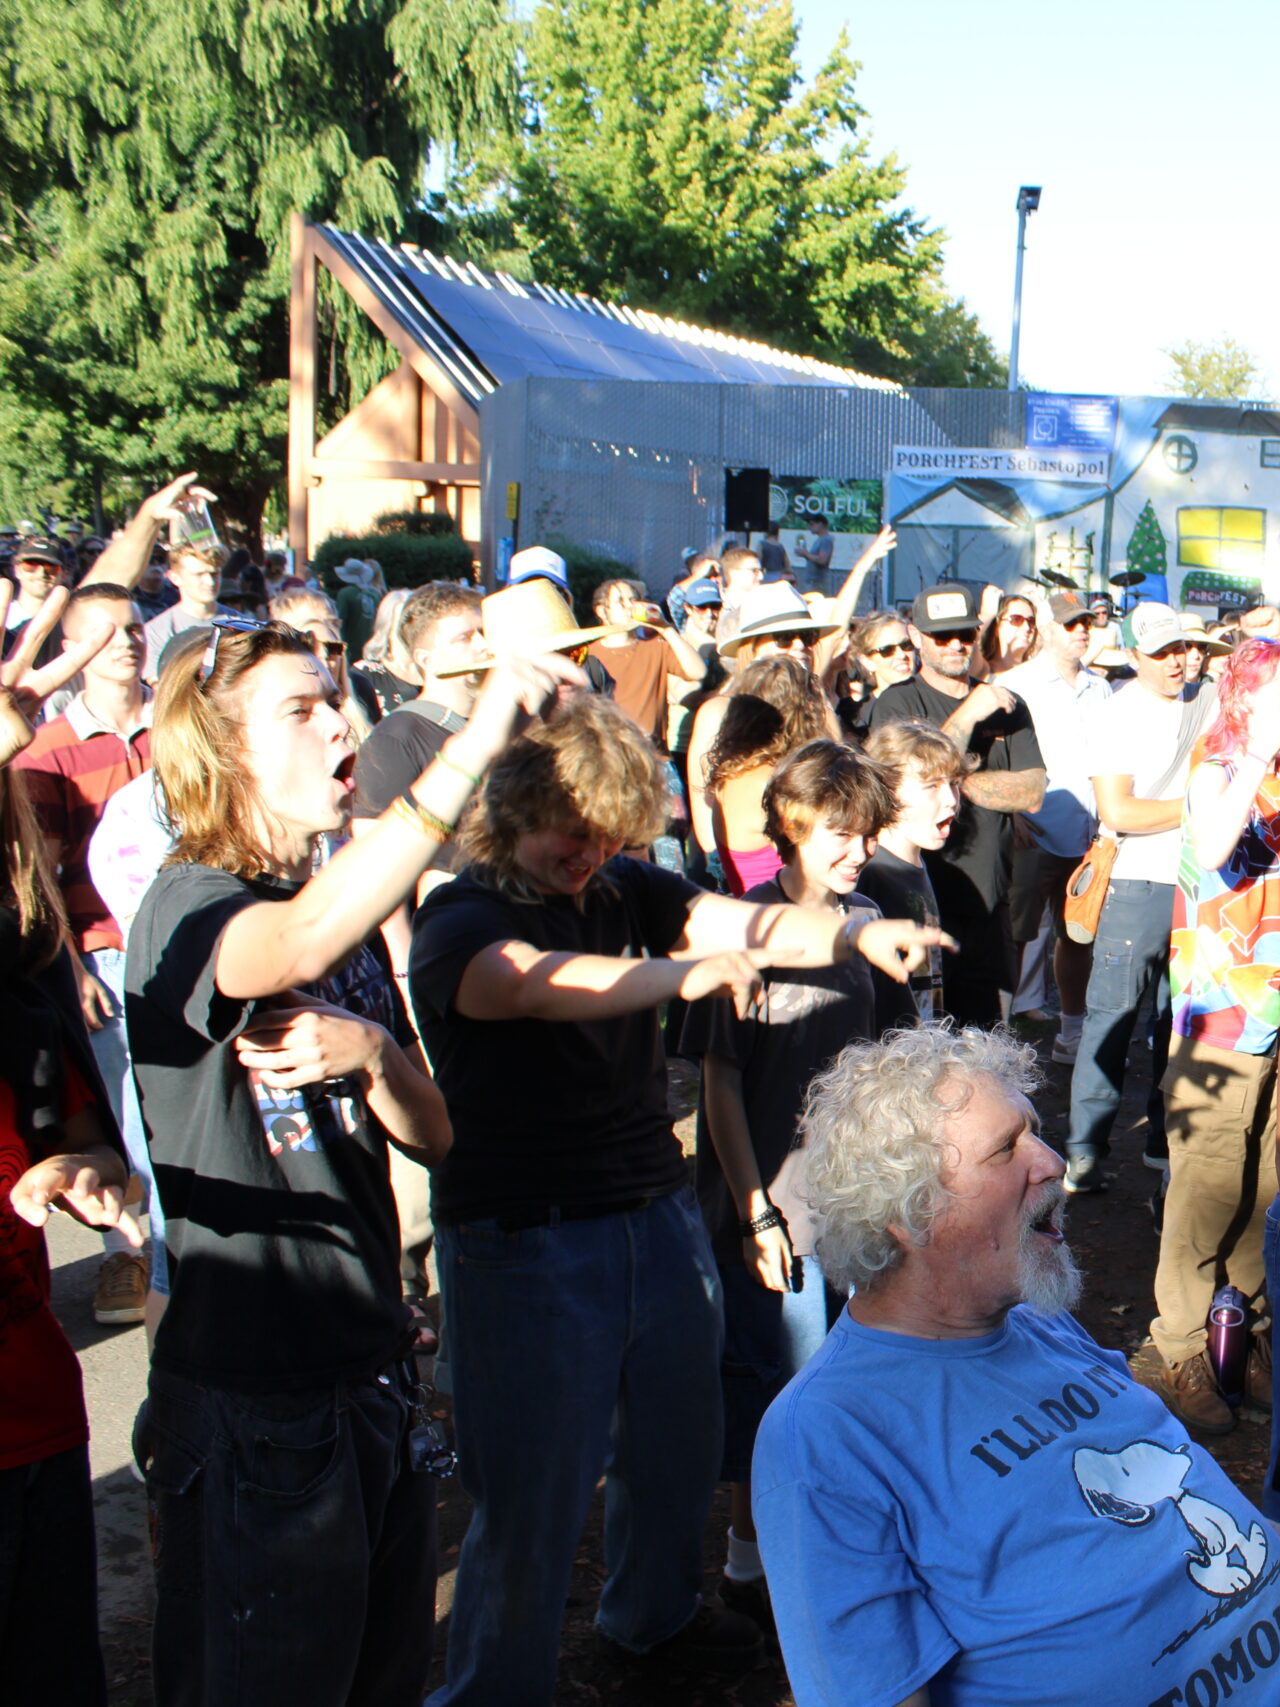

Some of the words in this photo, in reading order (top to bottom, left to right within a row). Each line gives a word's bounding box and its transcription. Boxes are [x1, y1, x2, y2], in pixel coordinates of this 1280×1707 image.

[896, 452, 1002, 471] PORCHFEST
[1006, 455, 1105, 477] Sebastopol
[793, 495, 873, 517] SOLFUL
[969, 1414, 1059, 1478] I'LL
[1038, 1383, 1100, 1433] DO
